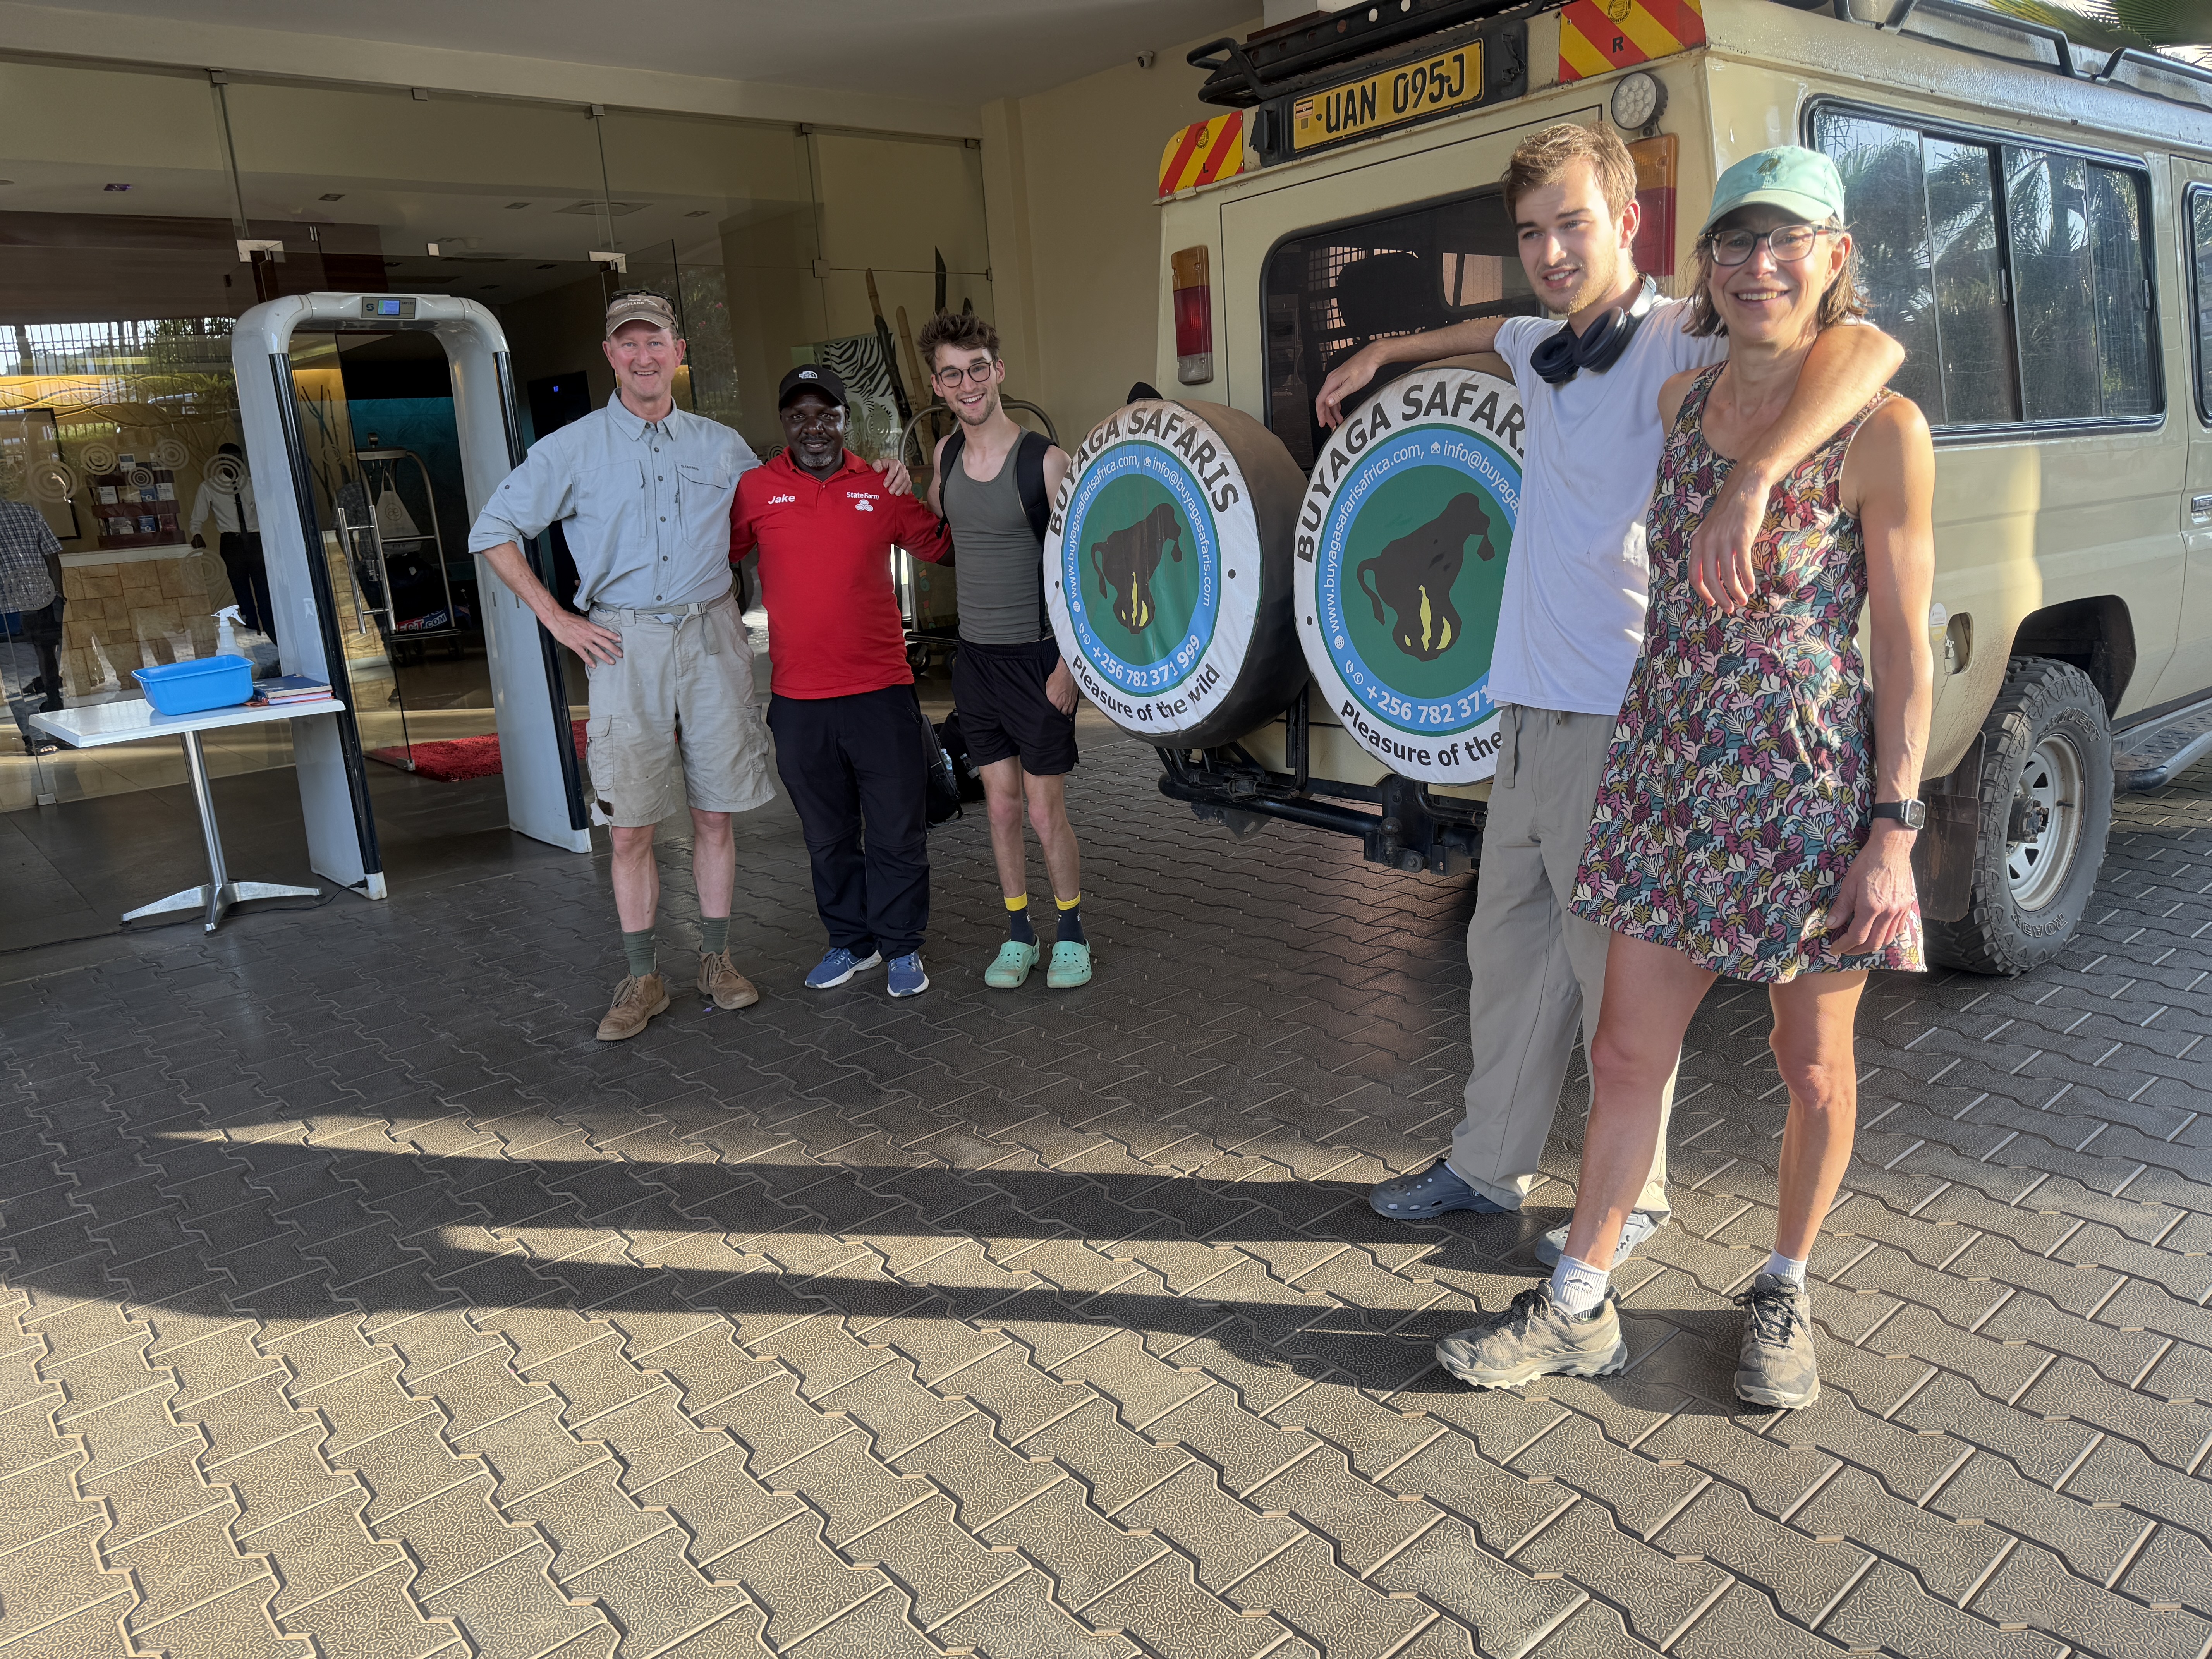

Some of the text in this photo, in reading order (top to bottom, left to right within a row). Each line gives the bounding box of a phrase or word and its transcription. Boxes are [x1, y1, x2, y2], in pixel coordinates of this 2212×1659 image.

[1612, 36, 1624, 53] R
[1326, 53, 1465, 134] UAN 095J
[768, 493, 796, 505] Jake
[1049, 407, 1240, 537] BUYAGA SAFARIS
[1297, 381, 1526, 563] BUYAGA SAFAR
[1067, 455, 1212, 607] www.buyagasafarisafrica.com, info@buyagasafaris.com
[1324, 444, 1425, 634] www.buyagasafarisafrica.com,
[1072, 655, 1221, 721] Pleasure of the wild
[1092, 634, 1200, 687] +256 782 371 999
[1341, 699, 1503, 766] Pleasure of the
[1366, 685, 1412, 720] +256
[1417, 704, 1455, 724] 782
